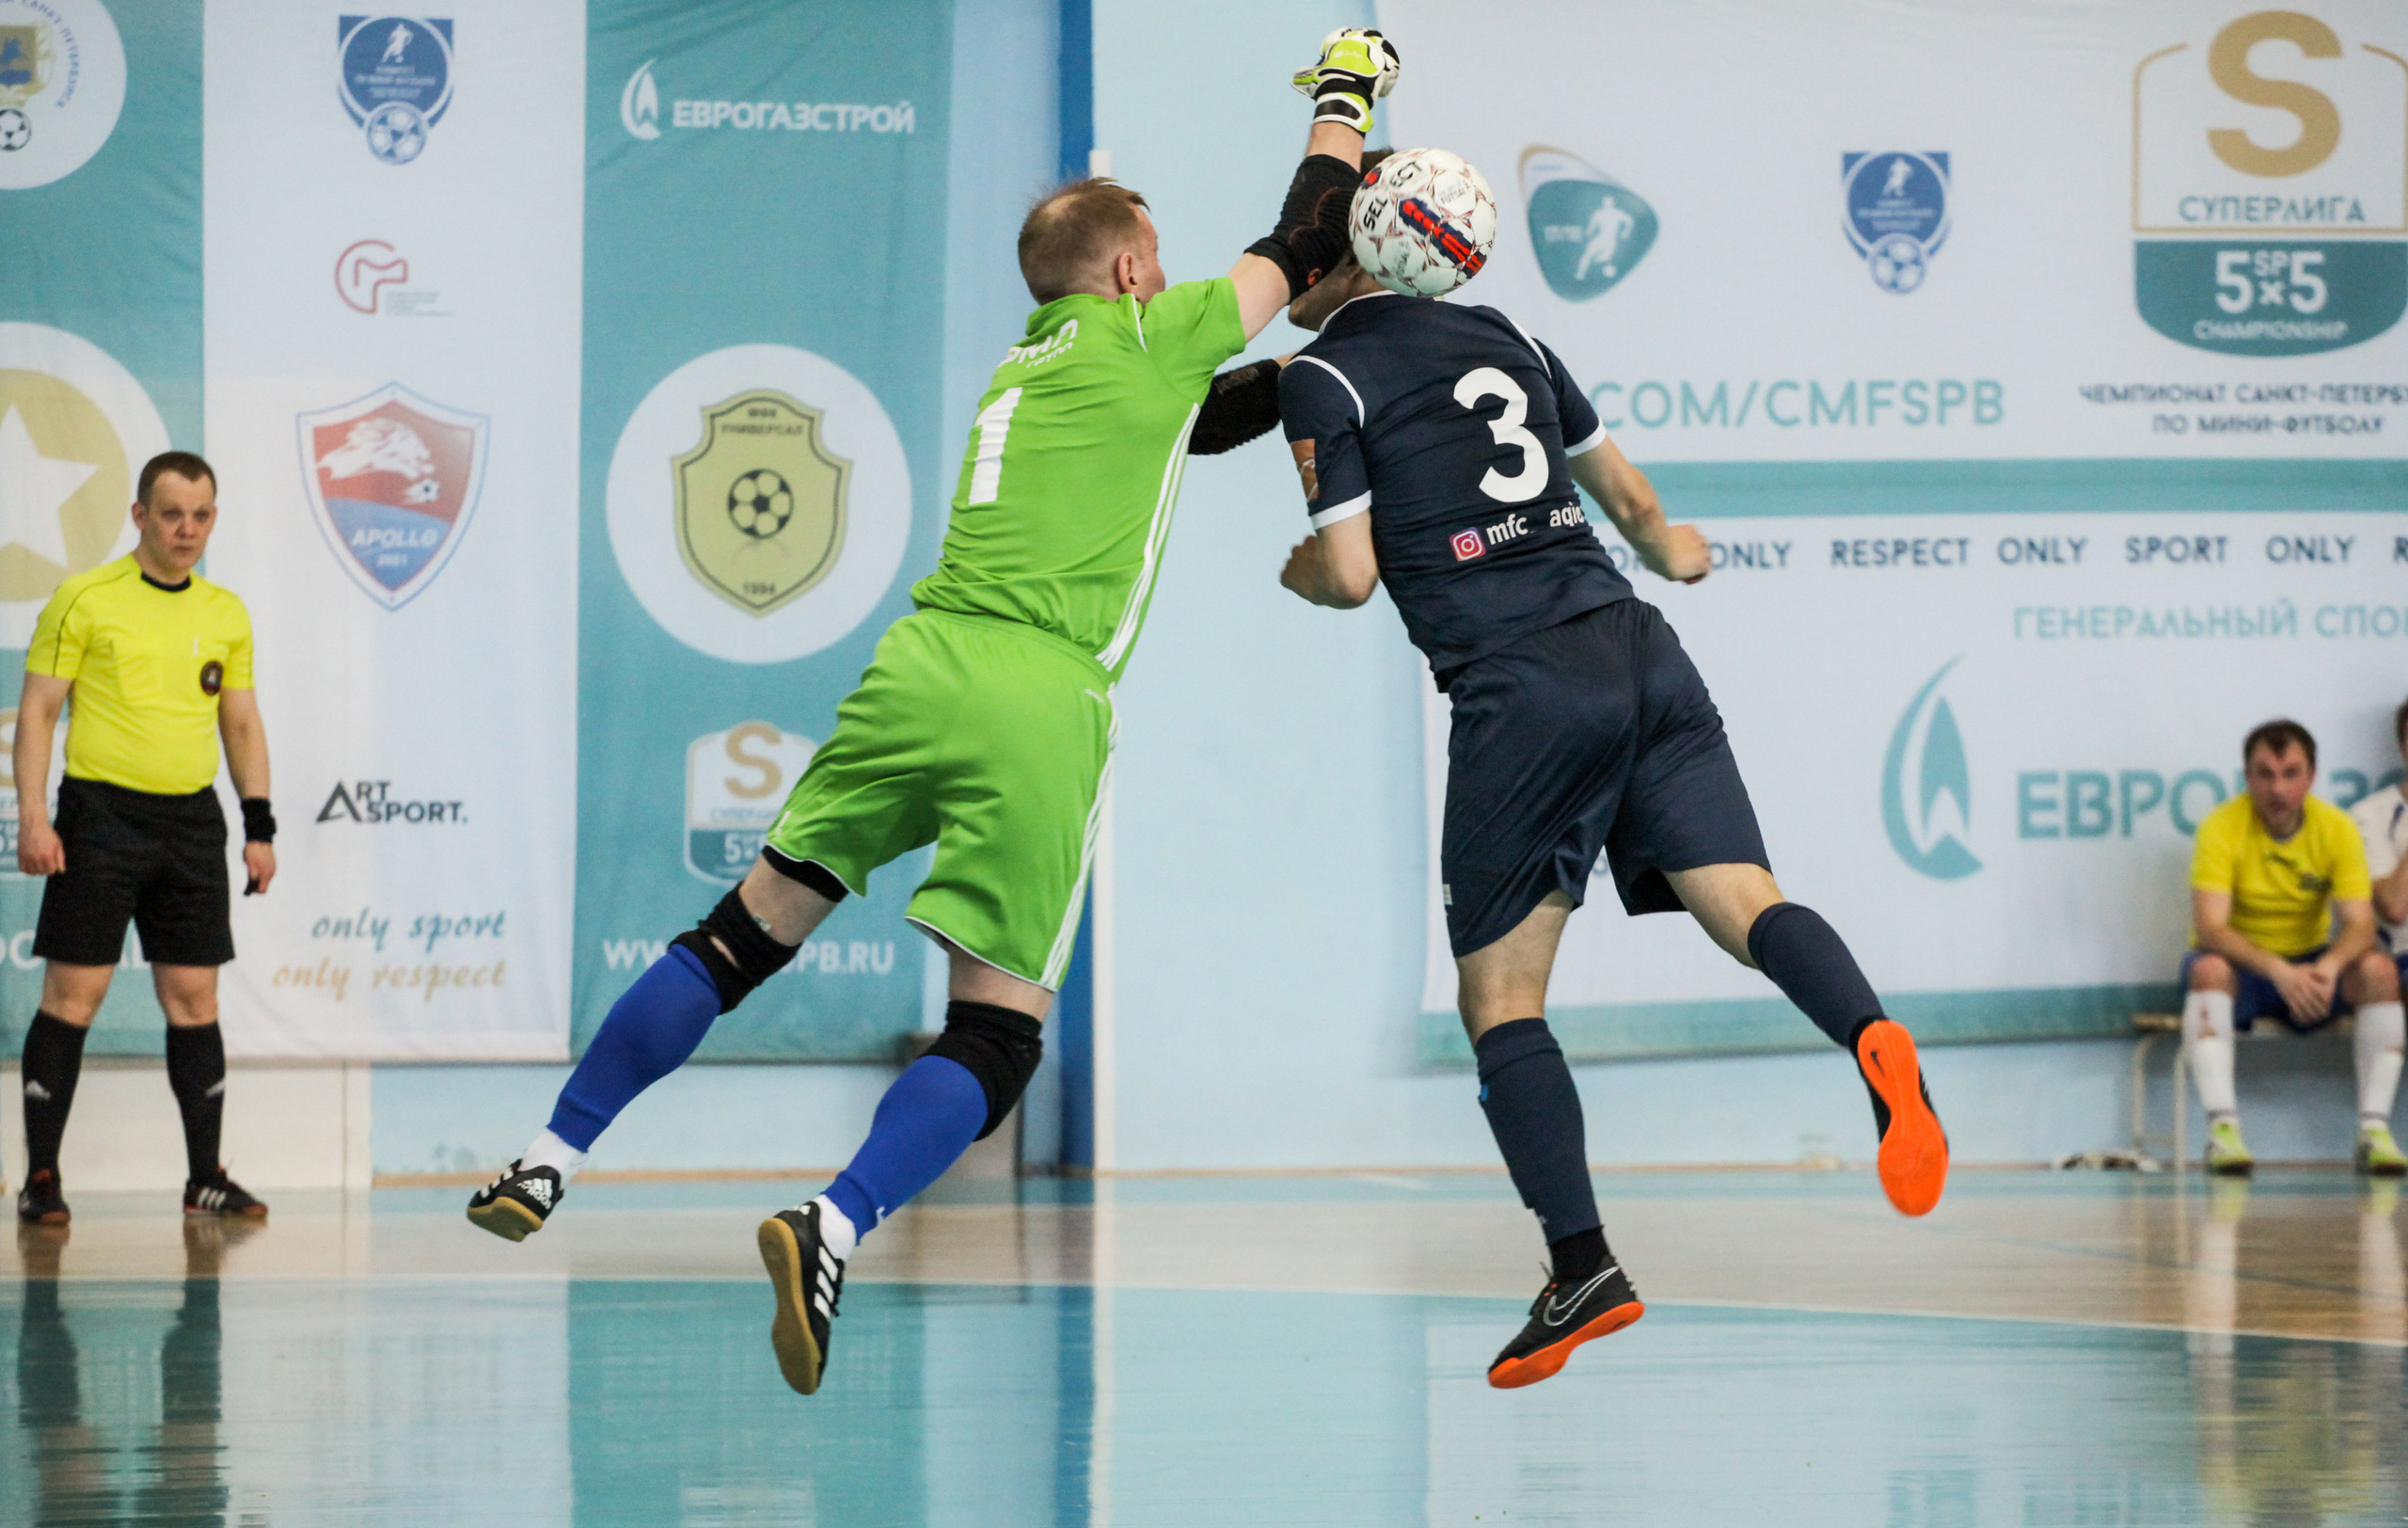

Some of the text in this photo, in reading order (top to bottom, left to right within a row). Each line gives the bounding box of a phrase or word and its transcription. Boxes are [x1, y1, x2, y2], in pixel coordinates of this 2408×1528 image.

[2206, 9, 2343, 178] S
[673, 100, 915, 134] ЕВРОГАЗСТРОЙ
[2178, 196, 2366, 223] СУПЕРЛИГА
[2193, 319, 2349, 341] CHAMPIONSHIP
[2079, 384, 2226, 405] ЧЕМПИОНАТ
[1453, 367, 1549, 502] 3
[2152, 414, 2189, 436] ПО
[968, 387, 1023, 505] 1
[352, 528, 438, 548] APOLLO
[1831, 537, 1970, 567] RESPECT
[1997, 536, 2088, 565] ONLY
[2125, 535, 2227, 564] SPORT
[2266, 535, 2355, 564] ONLY
[2014, 597, 2298, 640] ГЕНЕРАЛЬНЫЙ
[725, 720, 782, 799] S
[312, 907, 506, 954] only sport
[272, 957, 506, 1003] only respect
